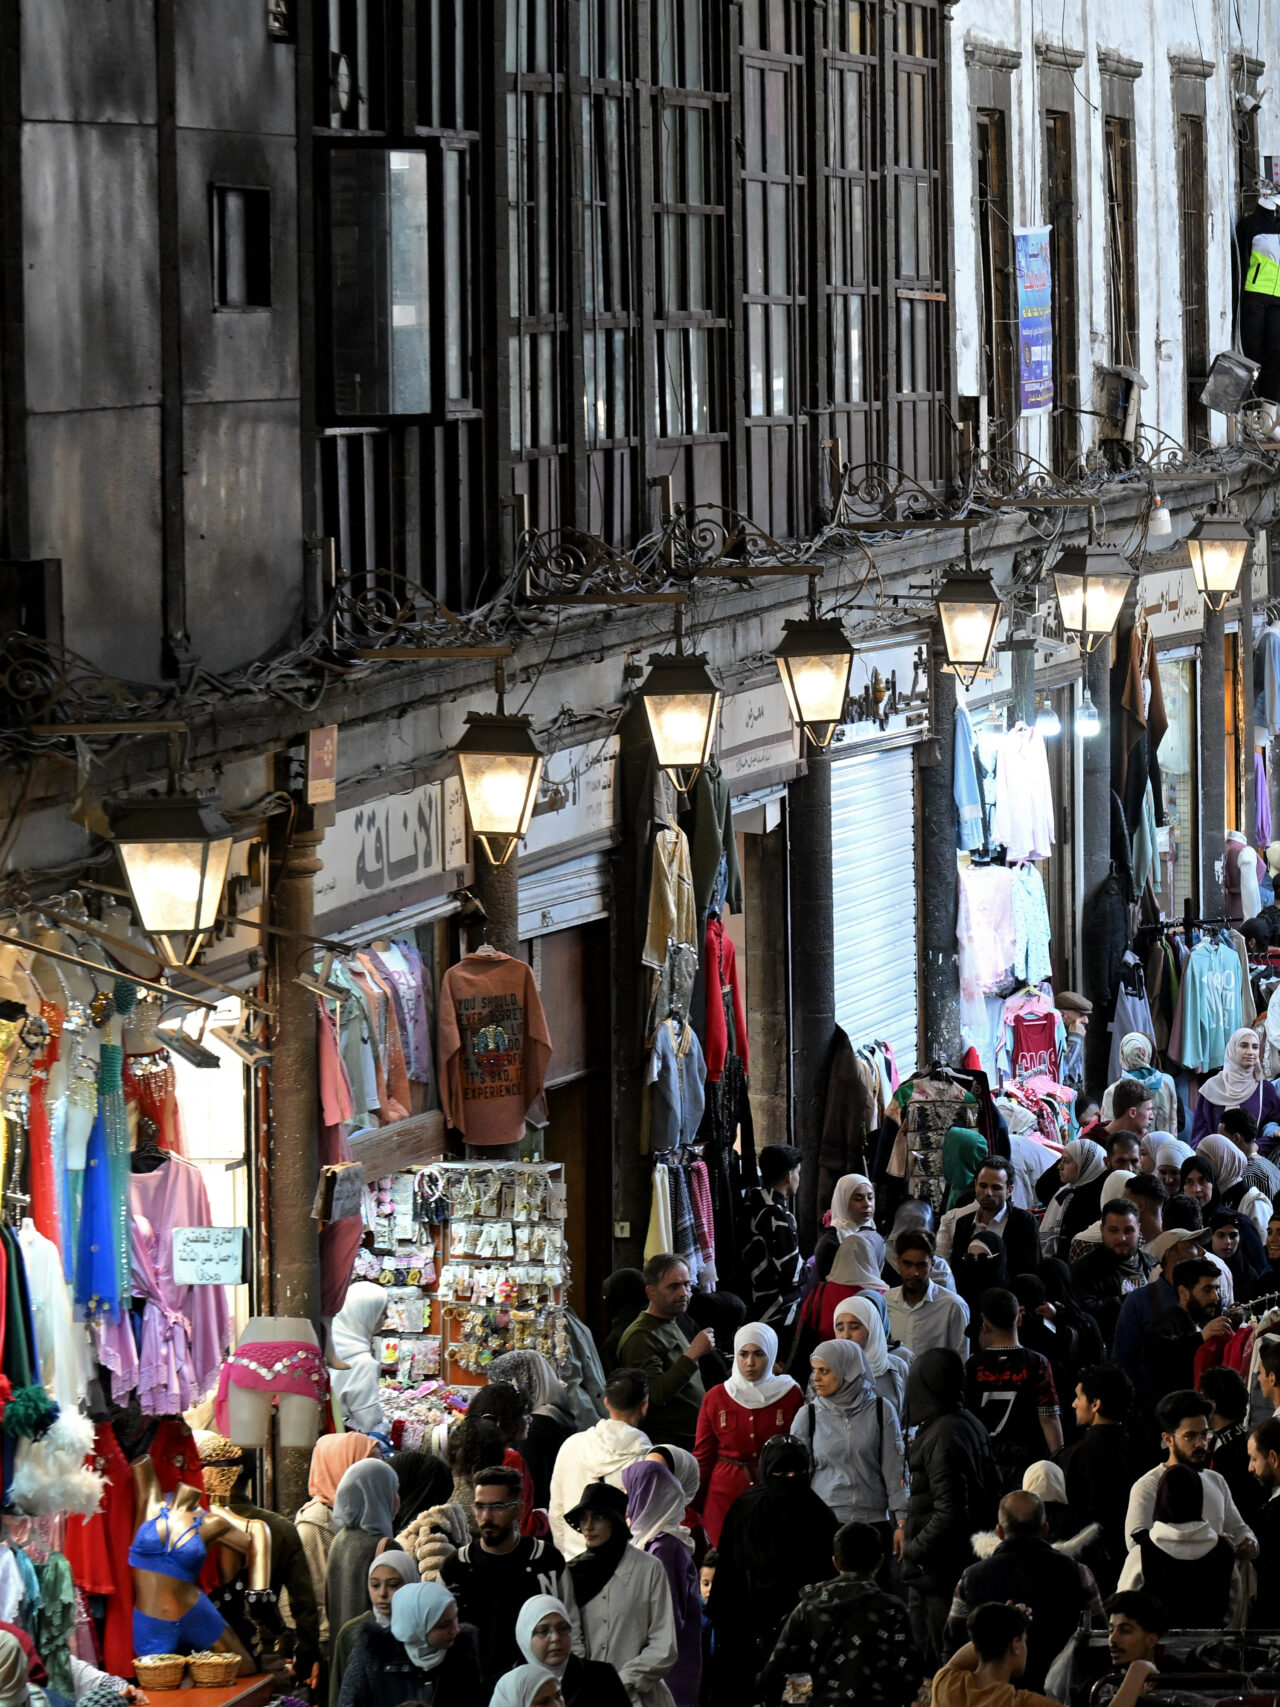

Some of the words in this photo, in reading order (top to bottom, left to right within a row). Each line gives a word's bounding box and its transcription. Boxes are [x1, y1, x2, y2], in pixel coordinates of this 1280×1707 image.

[457, 998, 476, 1010] YOU
[481, 993, 517, 1009] SHOULD
[981, 1391, 1018, 1437] 7
[537, 1570, 558, 1599] N
